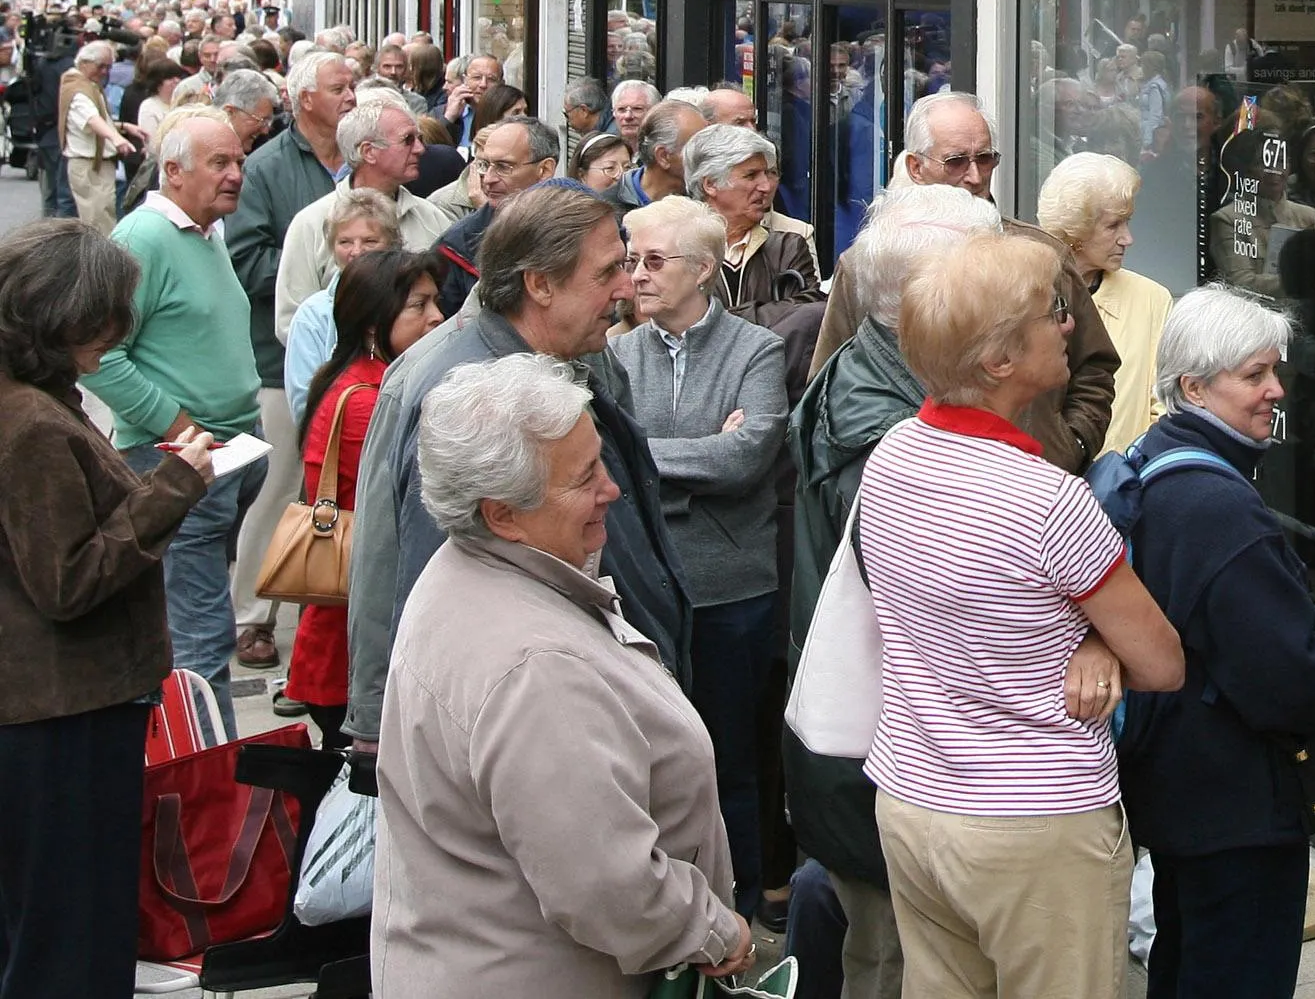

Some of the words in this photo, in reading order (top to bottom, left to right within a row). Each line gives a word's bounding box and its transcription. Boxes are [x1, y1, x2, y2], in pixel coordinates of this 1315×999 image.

[1254, 66, 1296, 81] savings
[1234, 191, 1257, 217] fixed
[1233, 217, 1253, 236] rate
[1233, 232, 1258, 259] bond
